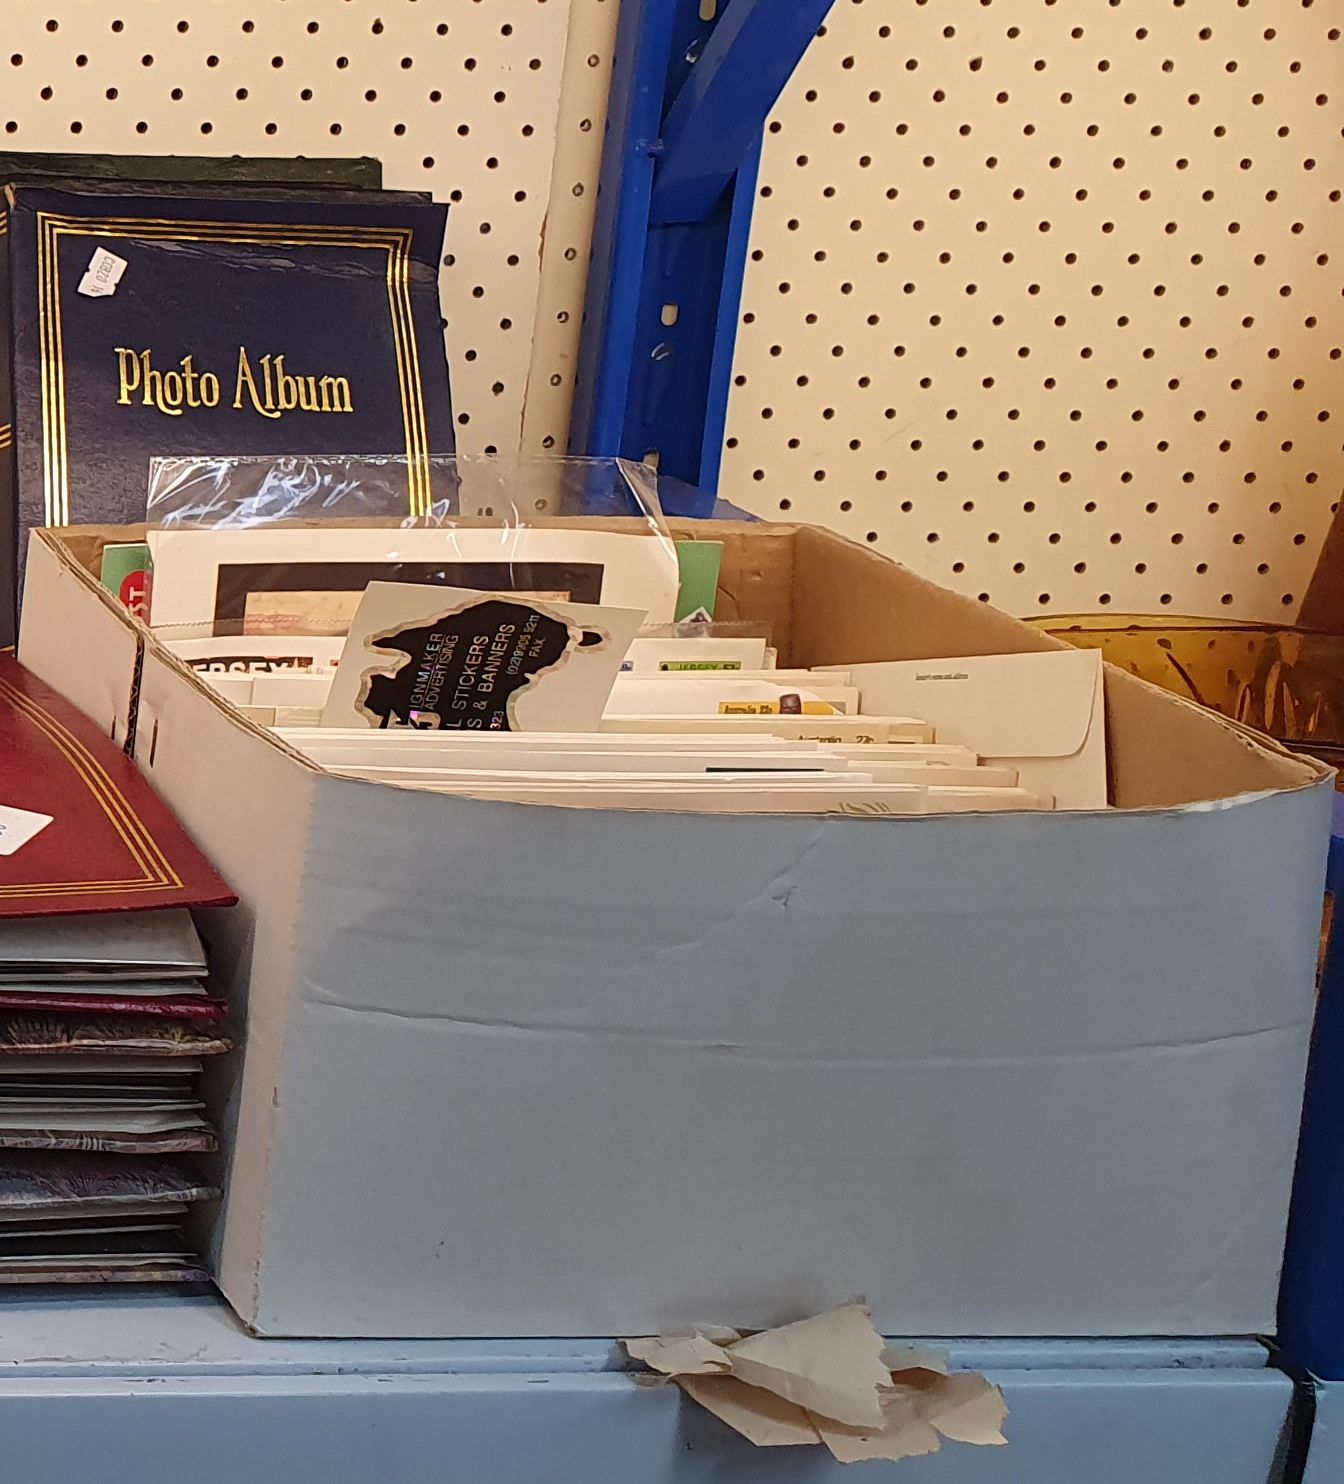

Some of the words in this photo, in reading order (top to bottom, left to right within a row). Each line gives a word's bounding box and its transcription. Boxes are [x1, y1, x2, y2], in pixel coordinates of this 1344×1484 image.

[114, 348, 220, 415] Photo
[232, 346, 353, 418] Album
[423, 634, 459, 711] ADVERTISING
[451, 635, 489, 711] STICKERS
[477, 624, 516, 693] BANNERS
